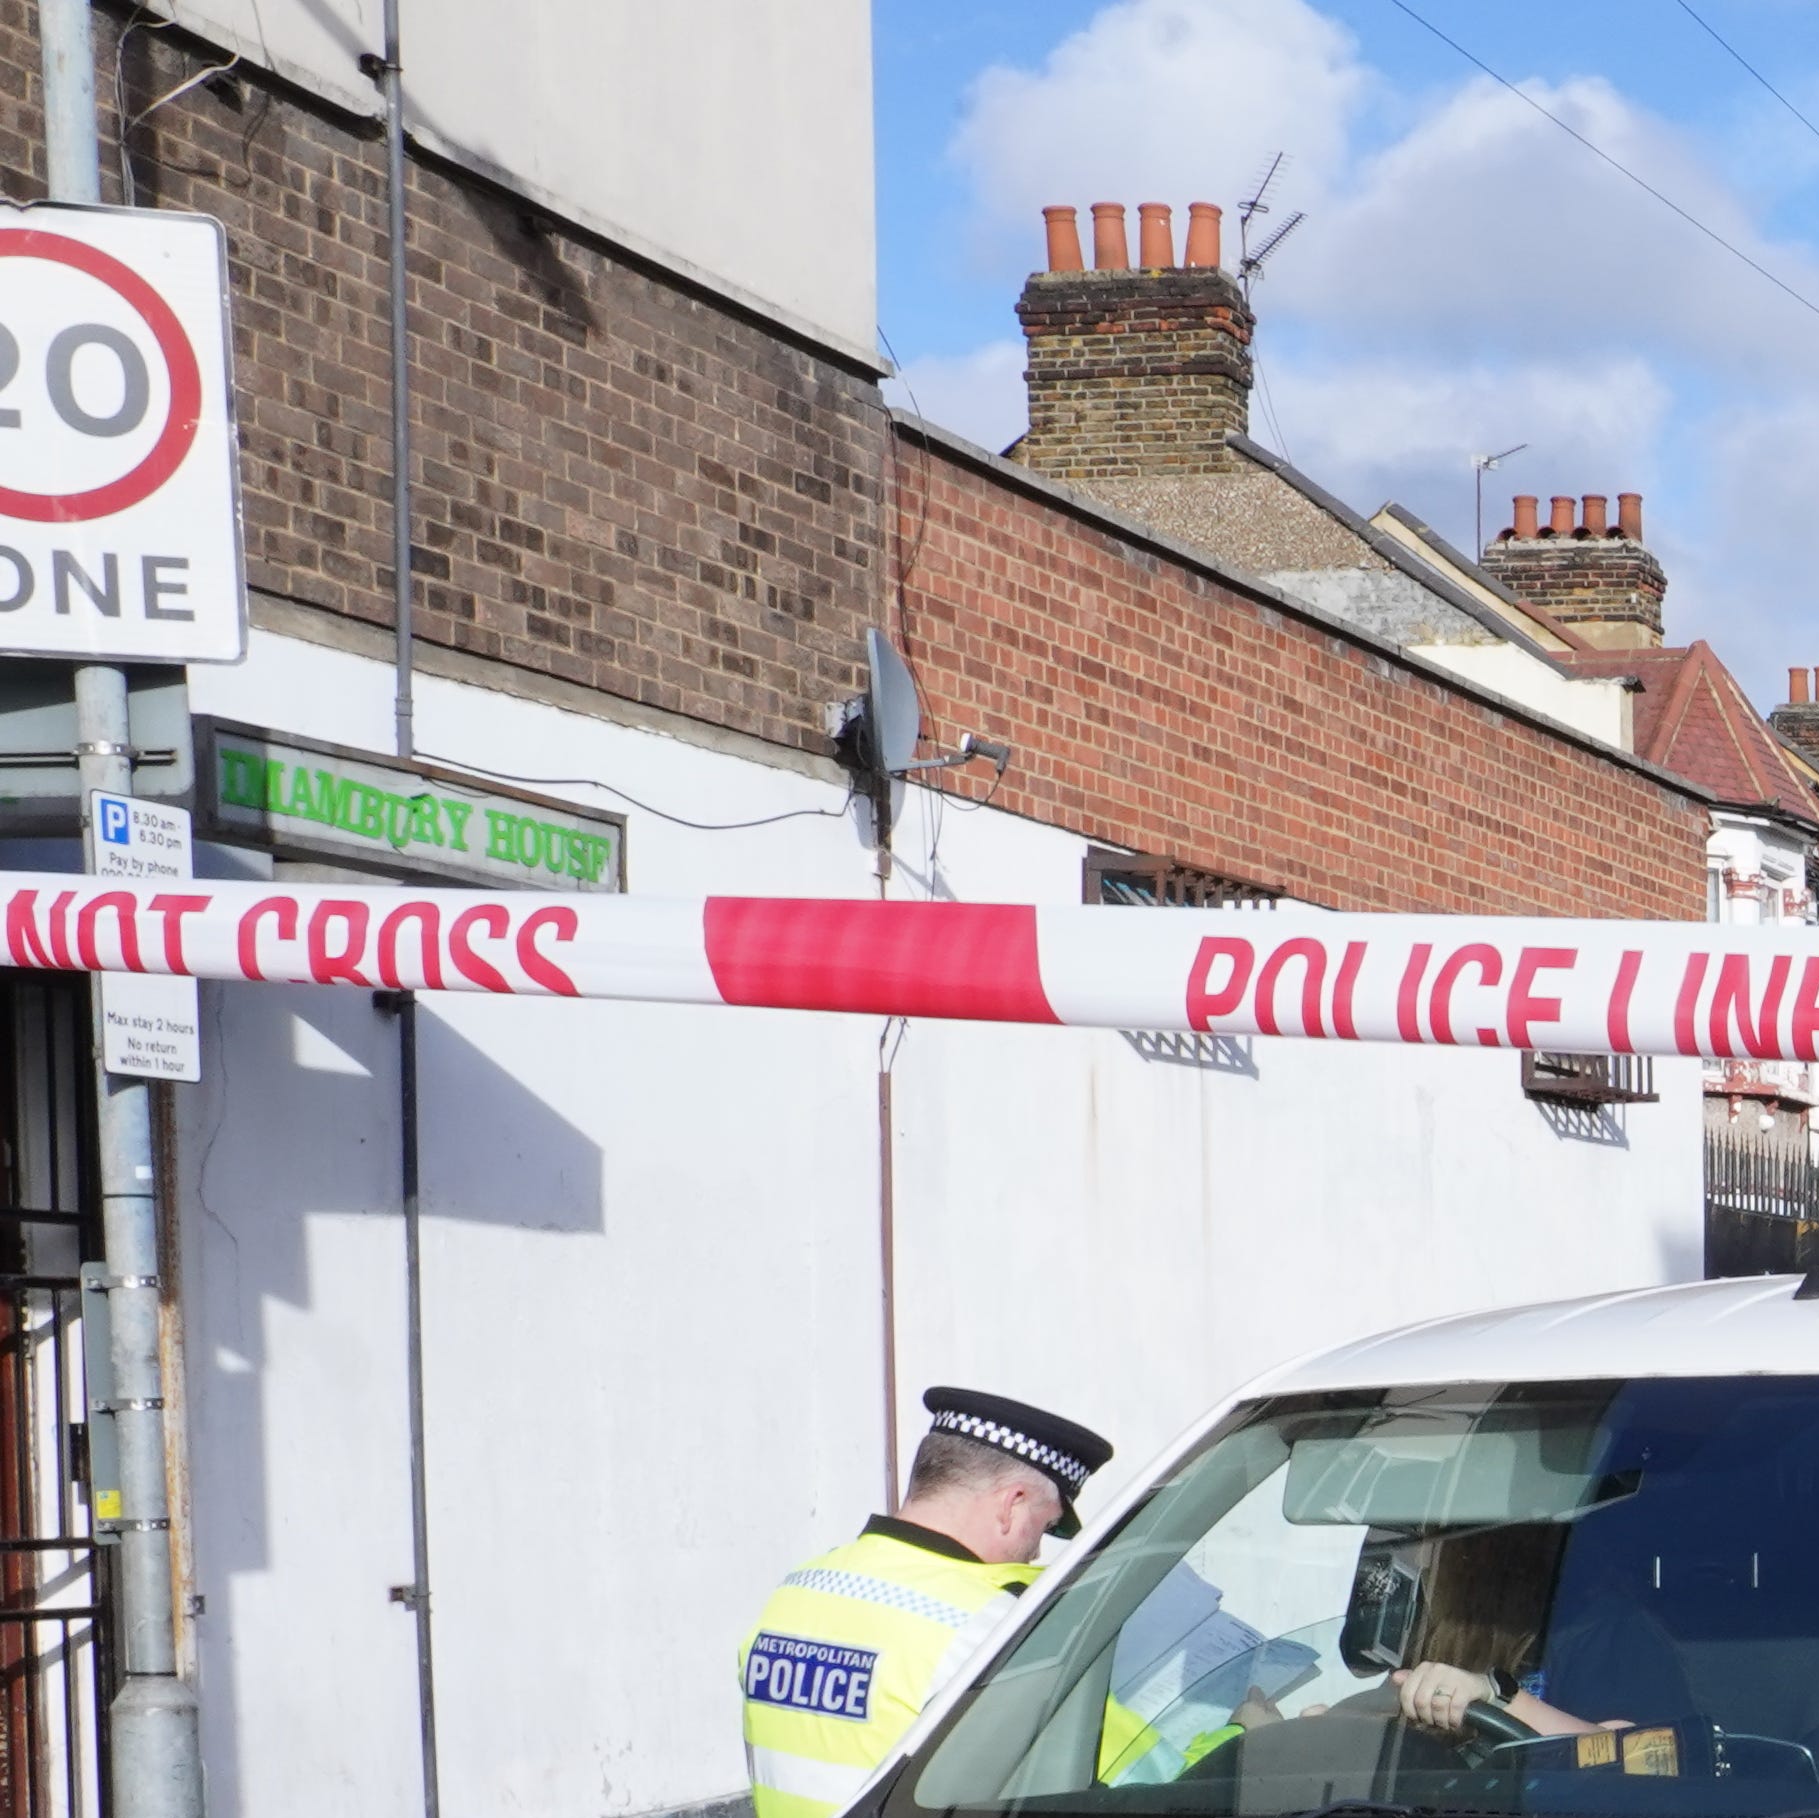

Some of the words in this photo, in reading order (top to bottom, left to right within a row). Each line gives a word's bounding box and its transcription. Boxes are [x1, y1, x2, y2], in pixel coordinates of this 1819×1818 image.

[0, 321, 150, 438] 0
[133, 811, 159, 828] 8.30
[166, 837, 182, 849] pm
[109, 851, 128, 869] Pay
[132, 857, 144, 873] by
[148, 861, 179, 878] phone
[5, 888, 214, 976] NOT
[1184, 935, 1578, 1049] POLICE
[107, 1011, 128, 1026] Max
[132, 1016, 153, 1032] stay
[156, 1018, 163, 1031] 2
[166, 1020, 195, 1036] hours
[127, 1037, 142, 1051] No
[145, 1040, 177, 1055] return
[120, 1054, 152, 1069] within
[162, 1059, 185, 1073] hour
[752, 1635, 874, 1670] METROPOLITAN
[747, 1653, 870, 1716] POLICE
